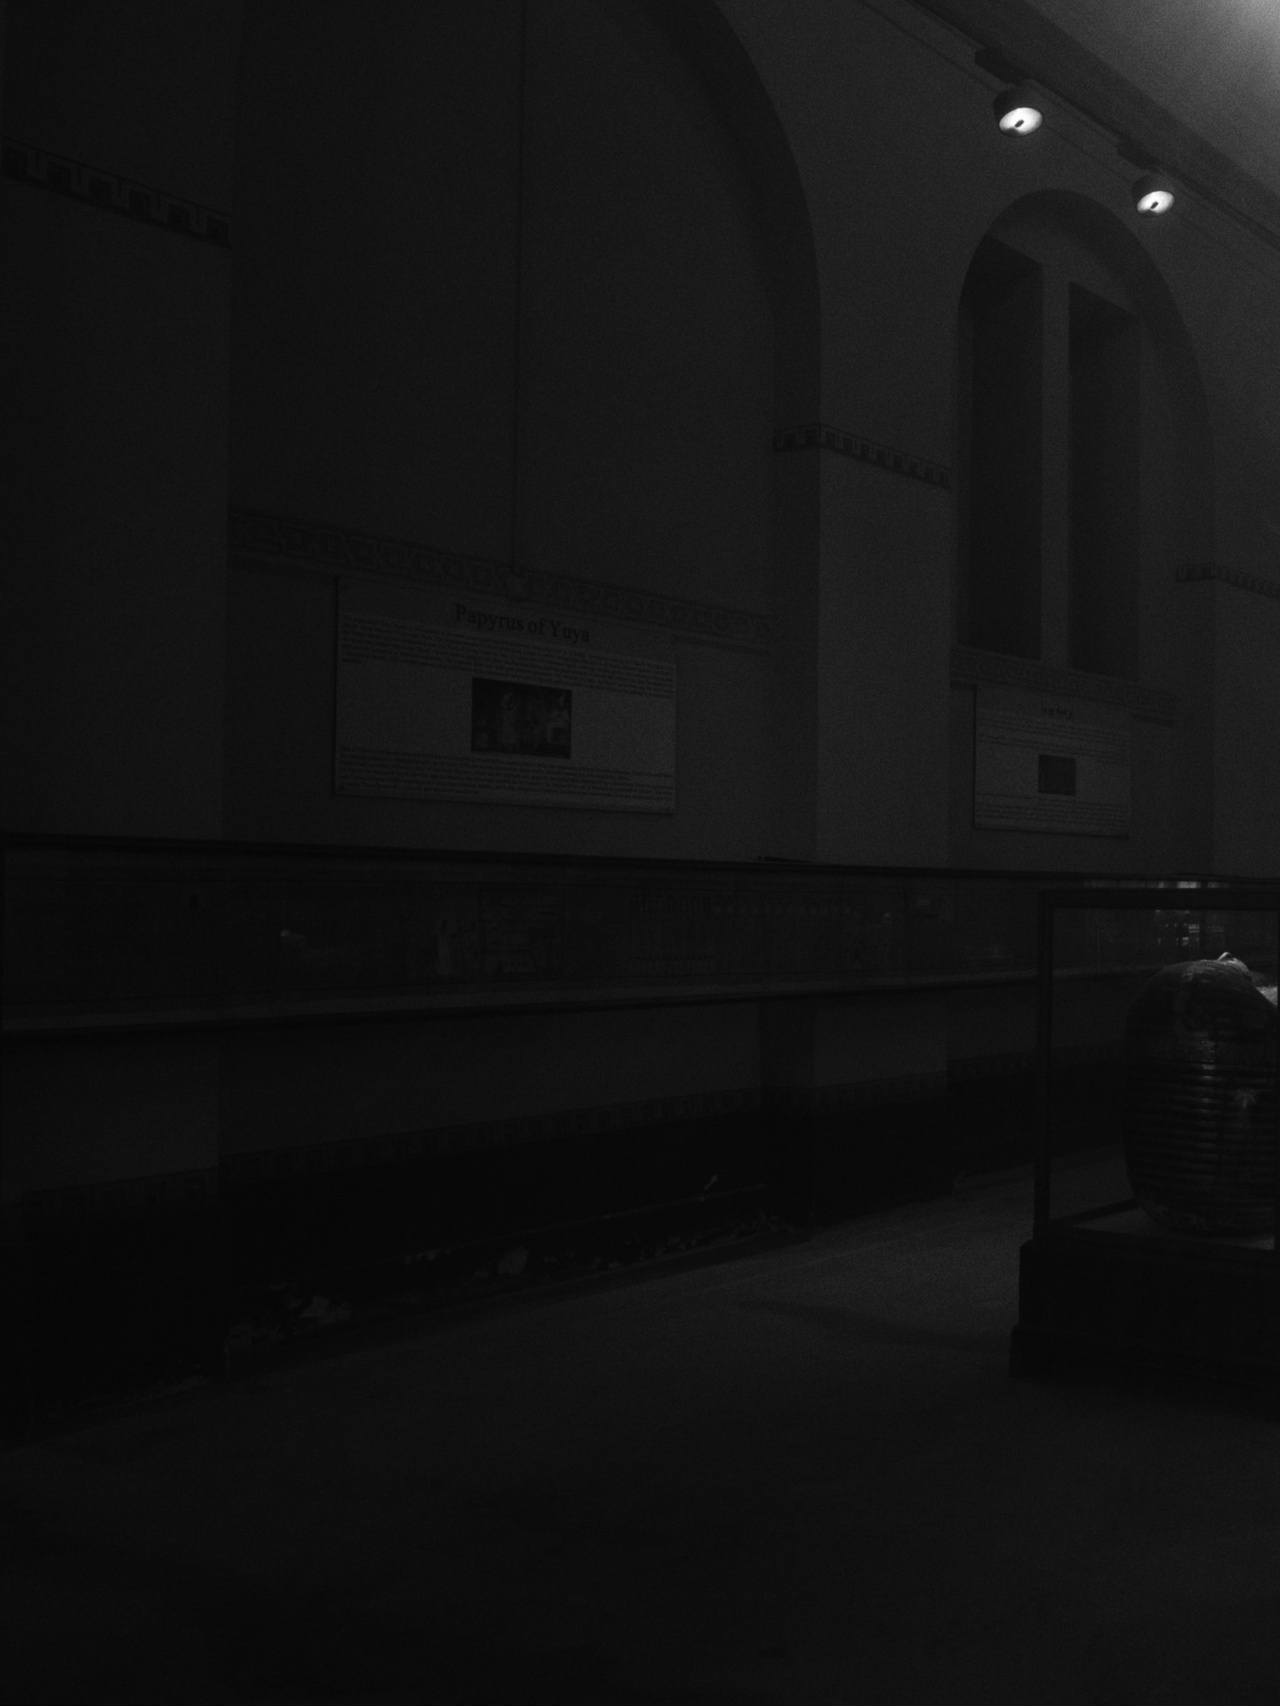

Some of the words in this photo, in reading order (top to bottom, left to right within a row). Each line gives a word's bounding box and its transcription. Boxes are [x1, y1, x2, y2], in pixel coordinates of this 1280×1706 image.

[455, 603, 524, 631] Papyrus
[528, 617, 547, 635] of
[549, 619, 590, 644] Yuya
